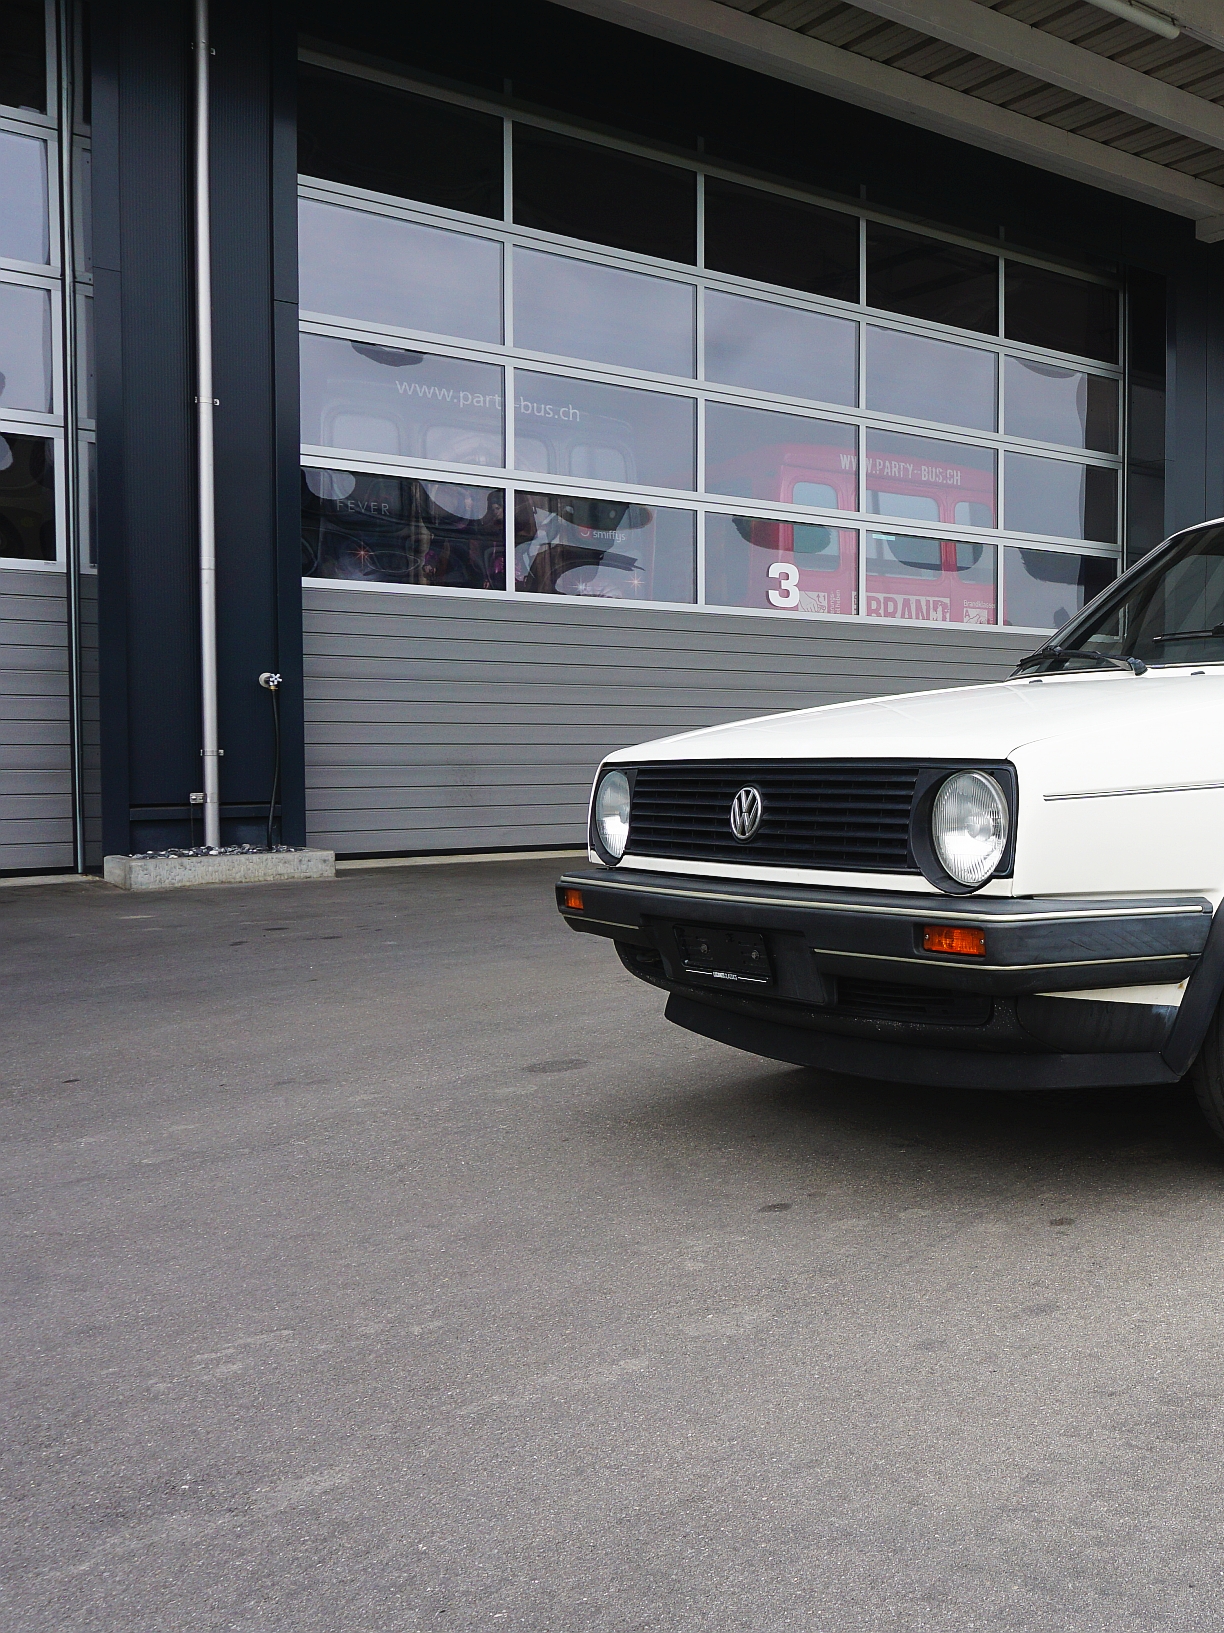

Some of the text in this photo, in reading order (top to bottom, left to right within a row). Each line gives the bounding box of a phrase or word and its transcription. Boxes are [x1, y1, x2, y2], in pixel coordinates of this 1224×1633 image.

[396, 381, 581, 422] www.part-bus.ch
[336, 500, 390, 515] FEVER
[592, 530, 626, 543] smiffys
[767, 562, 800, 608] 3
